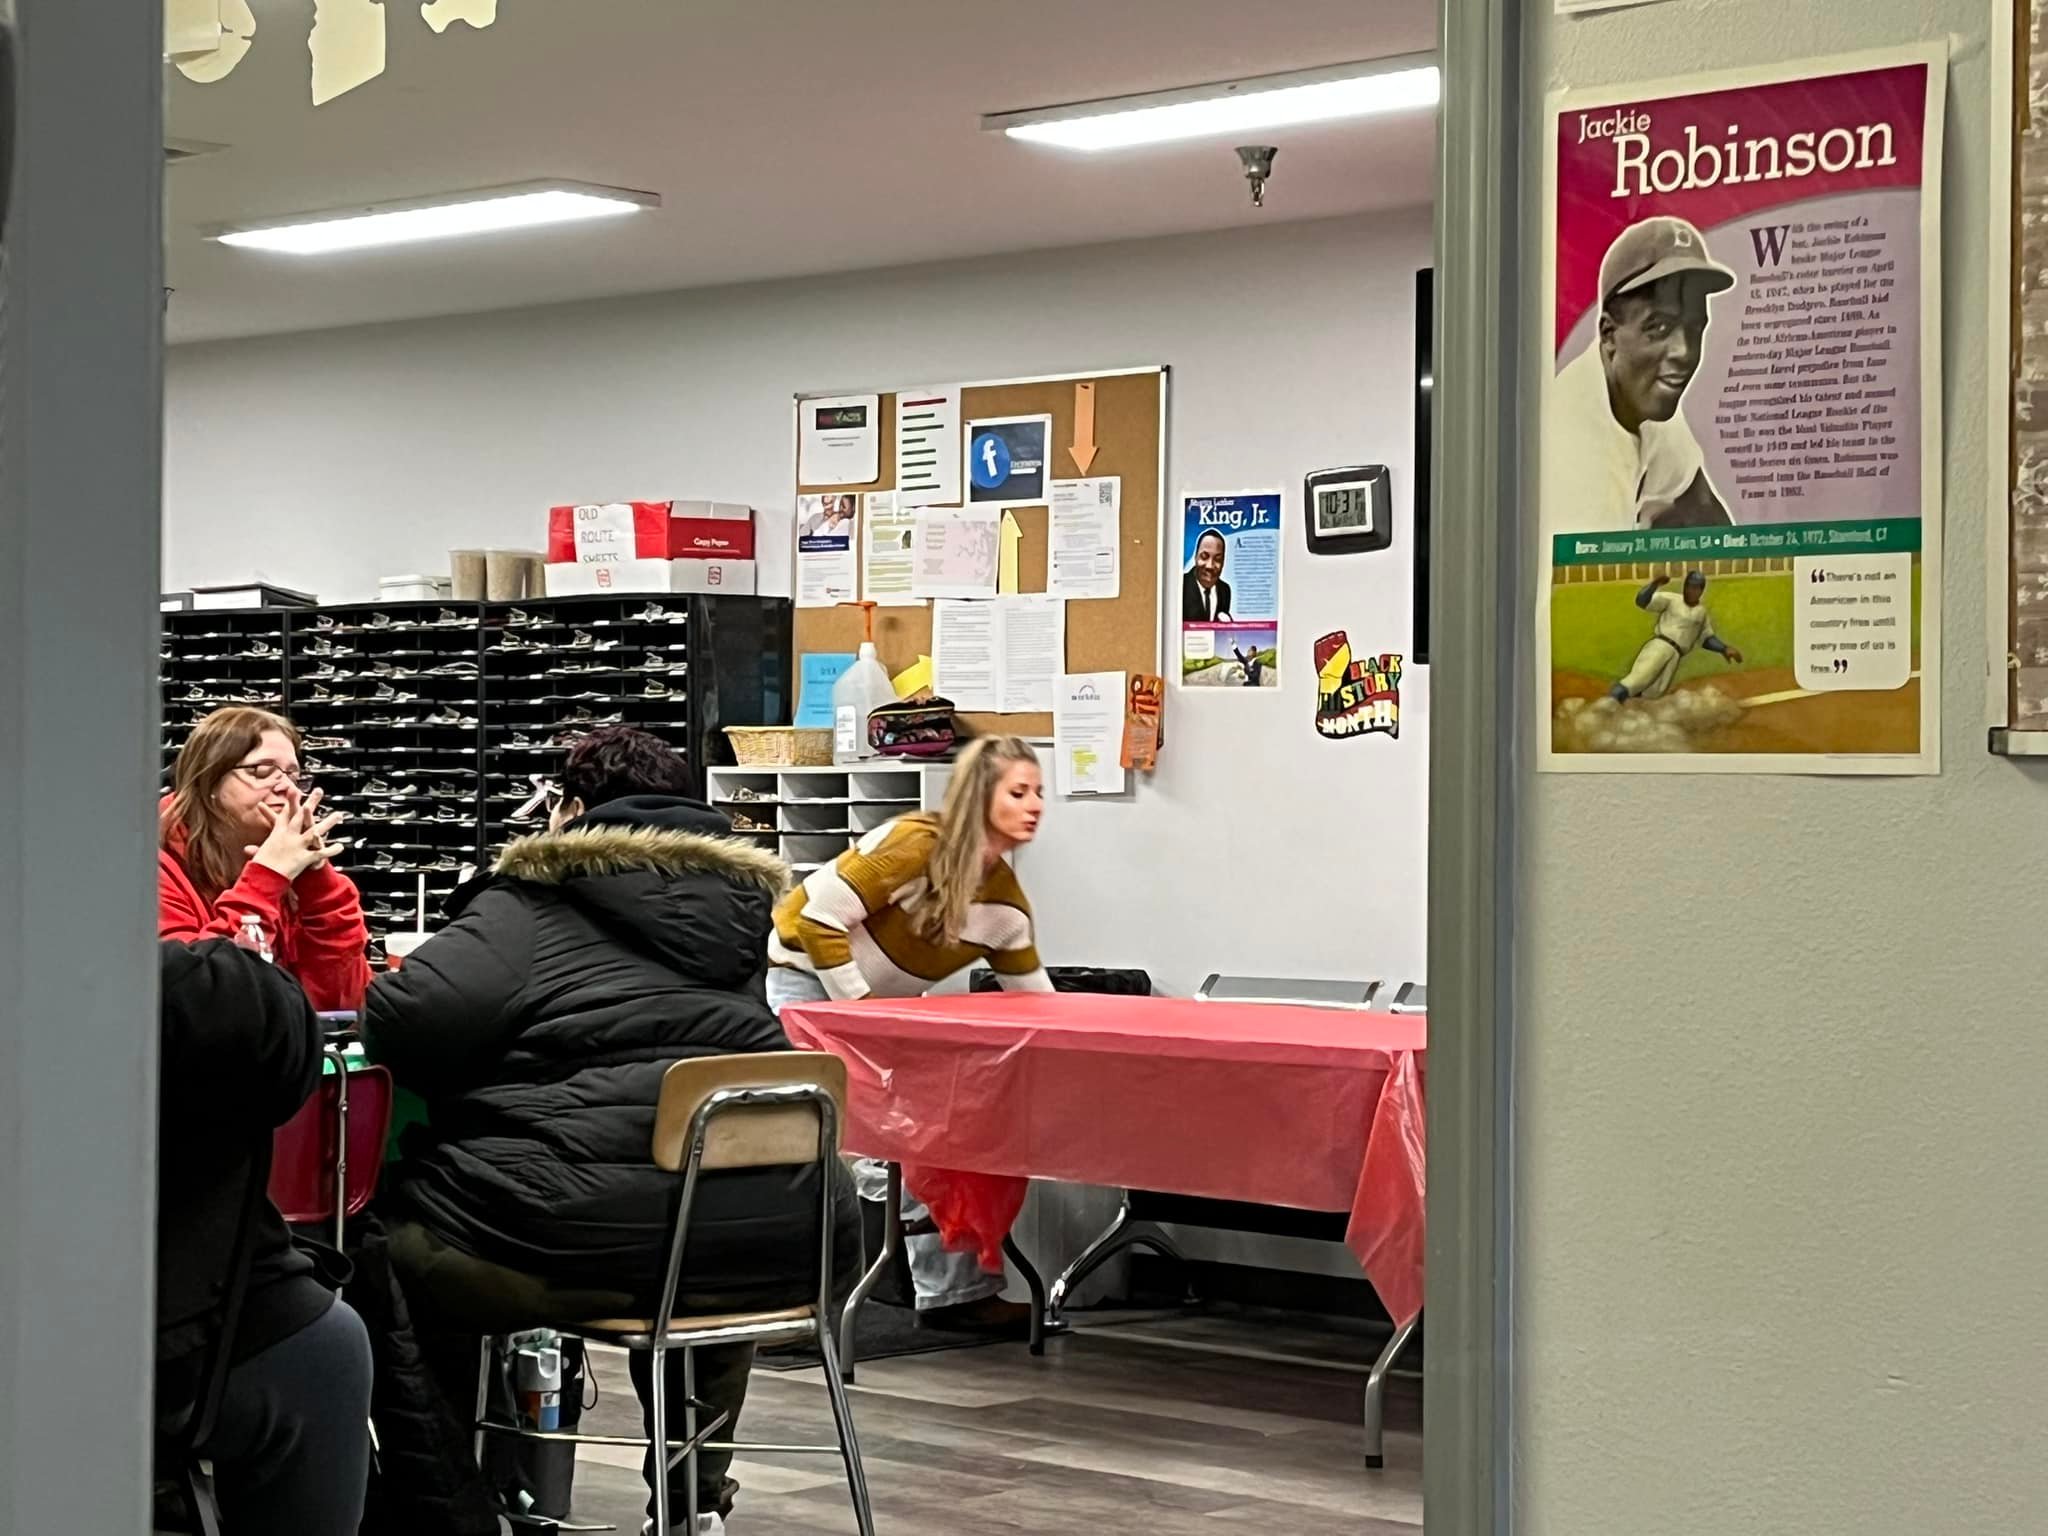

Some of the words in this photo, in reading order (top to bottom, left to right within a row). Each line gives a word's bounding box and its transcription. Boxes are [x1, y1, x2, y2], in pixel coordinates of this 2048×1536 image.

[1577, 109, 1652, 144] Jackie
[1611, 122, 1896, 198] Robinson
[578, 508, 598, 520] OLD
[1199, 505, 1247, 529] King,
[1251, 503, 1270, 527] Jr.
[581, 530, 615, 543] ROUTE
[1350, 655, 1400, 680] BLACK
[1319, 672, 1400, 711] HISTORY
[1321, 699, 1394, 735] MONTH
